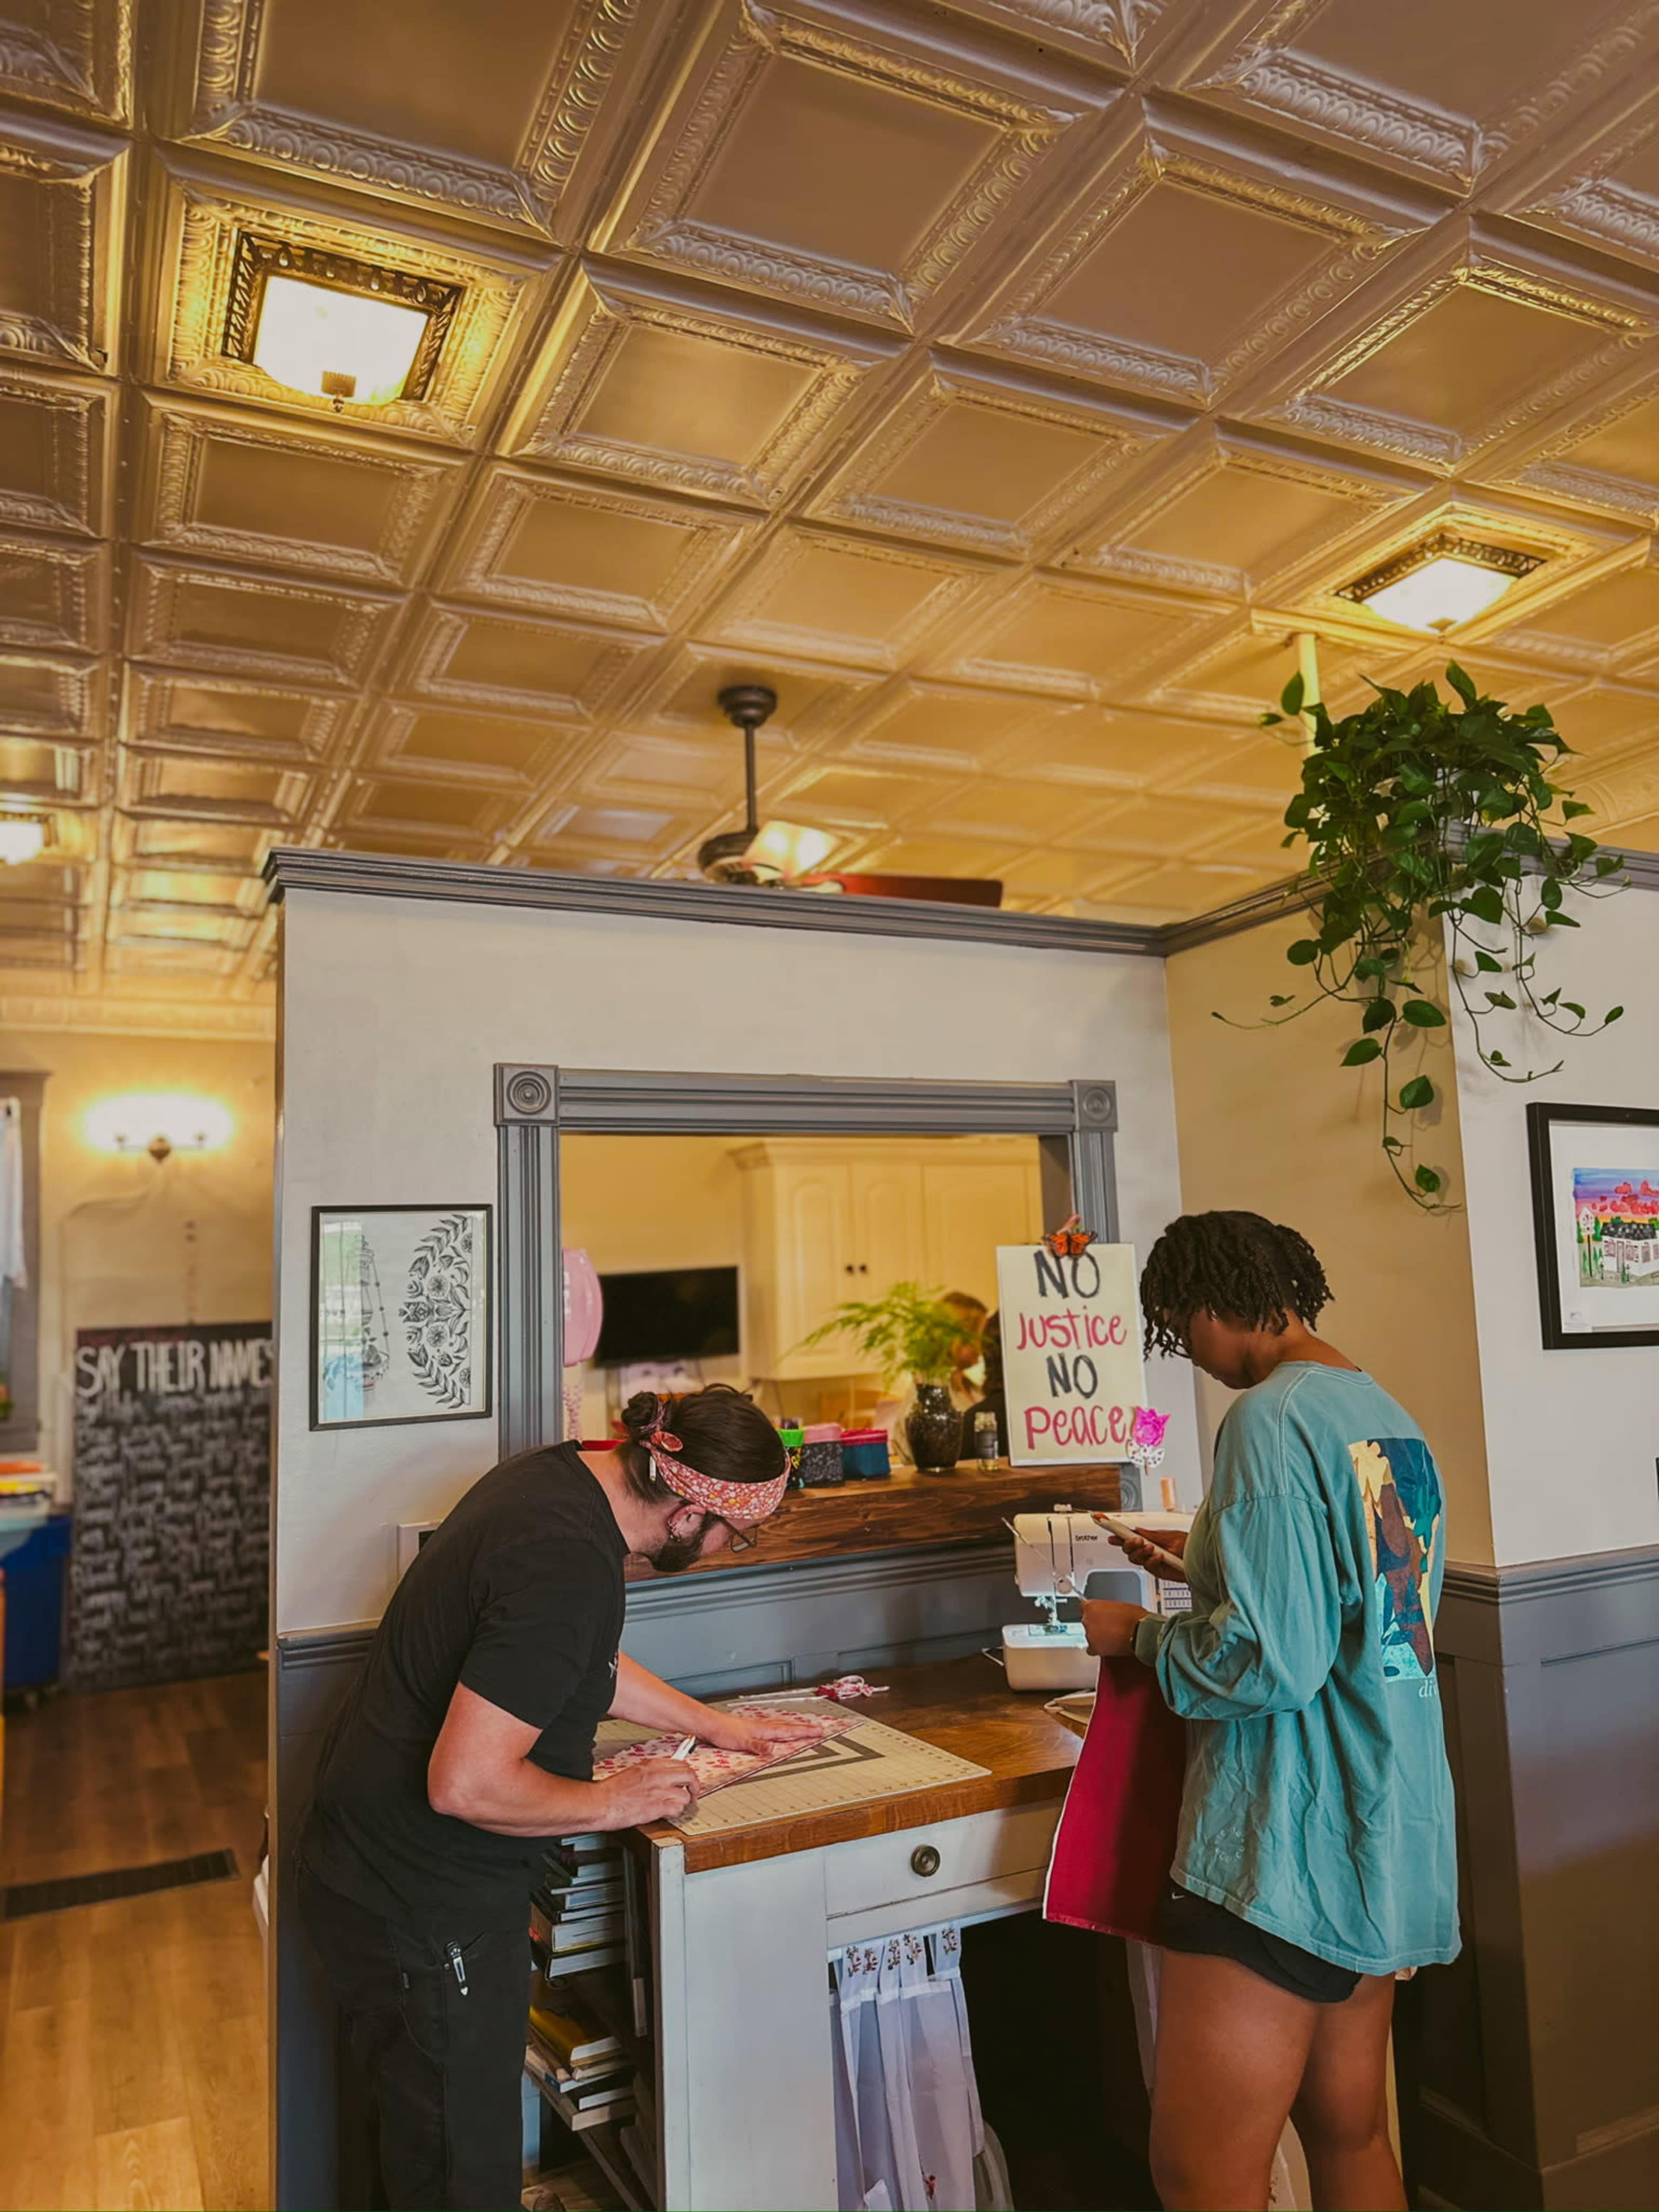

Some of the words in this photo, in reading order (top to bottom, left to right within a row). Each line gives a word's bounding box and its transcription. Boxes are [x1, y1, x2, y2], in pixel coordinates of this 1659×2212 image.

[1033, 1250, 1100, 1299] NO
[76, 1344, 126, 1398] SAY
[130, 1340, 206, 1394] THEIR
[1046, 1352, 1098, 1399] NO
[1024, 1405, 1126, 1450] Peace
